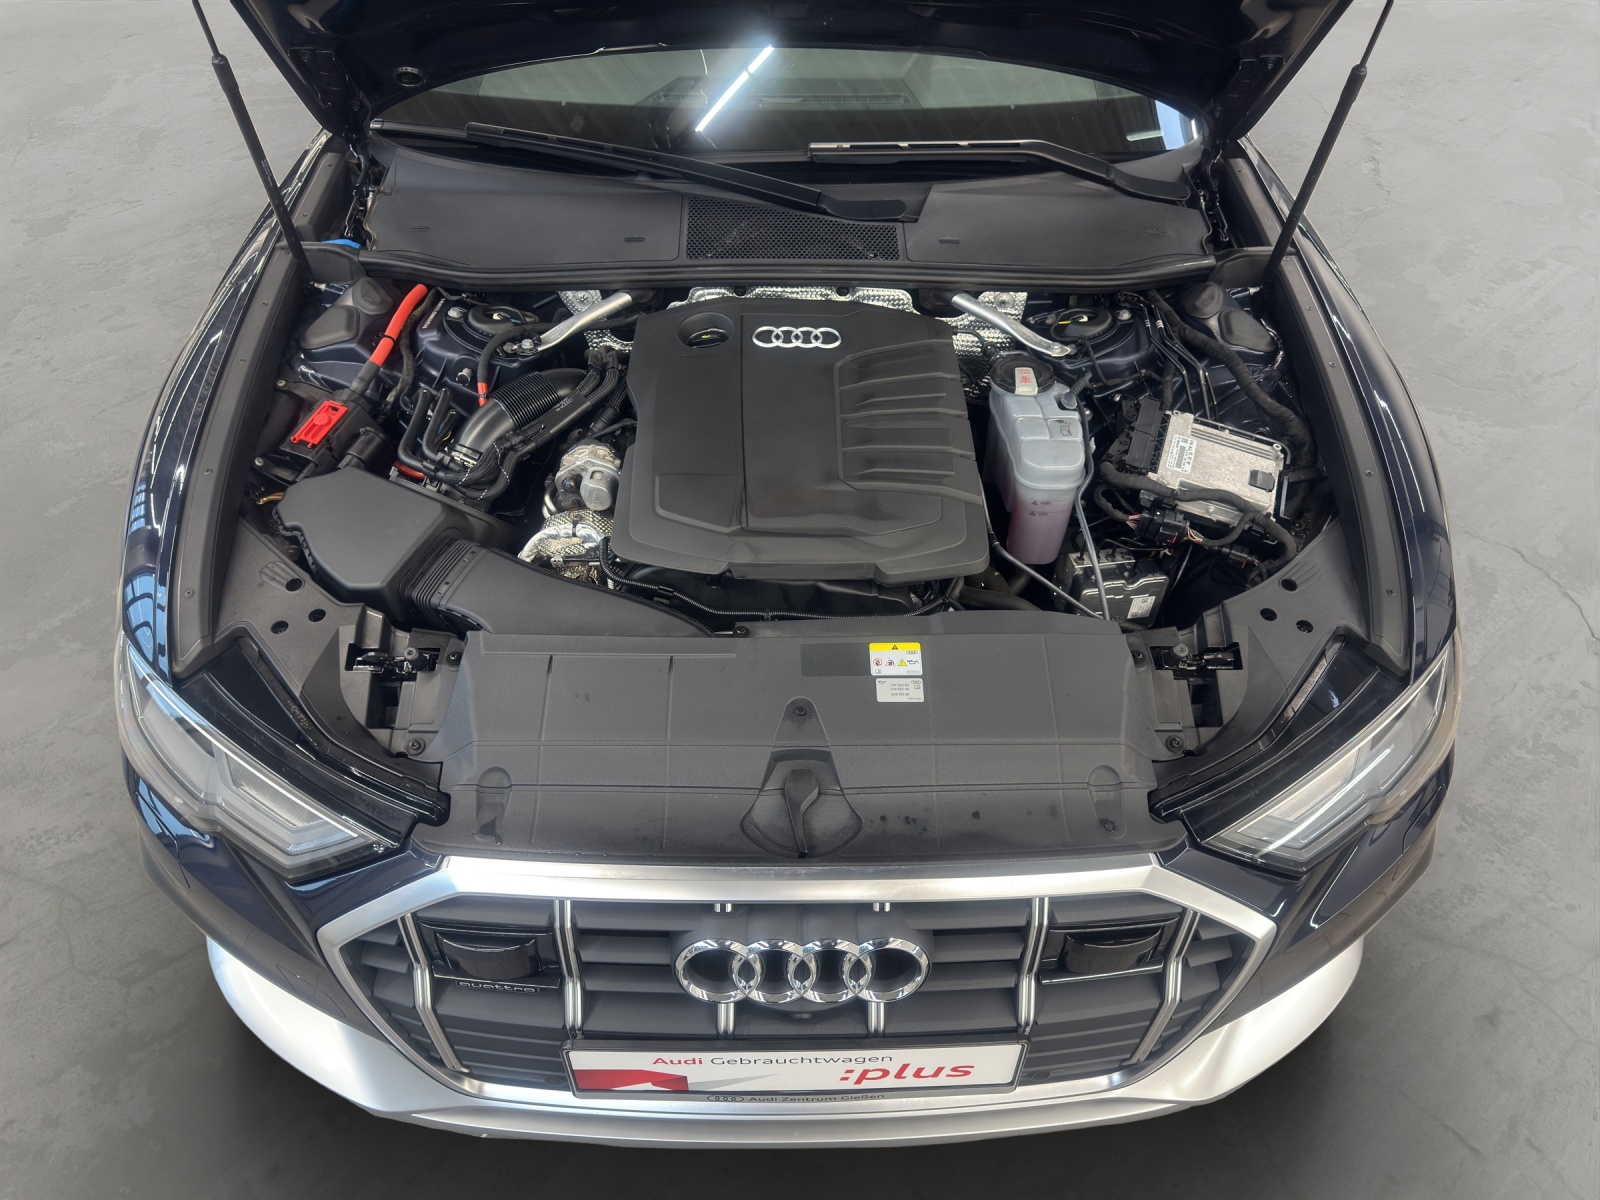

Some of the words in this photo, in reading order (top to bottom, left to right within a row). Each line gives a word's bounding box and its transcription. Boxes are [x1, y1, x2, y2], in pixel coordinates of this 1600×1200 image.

[459, 981, 535, 992] quattro
[652, 1057, 703, 1065] Audi
[710, 1055, 893, 1065] Gebrauchtwagen
